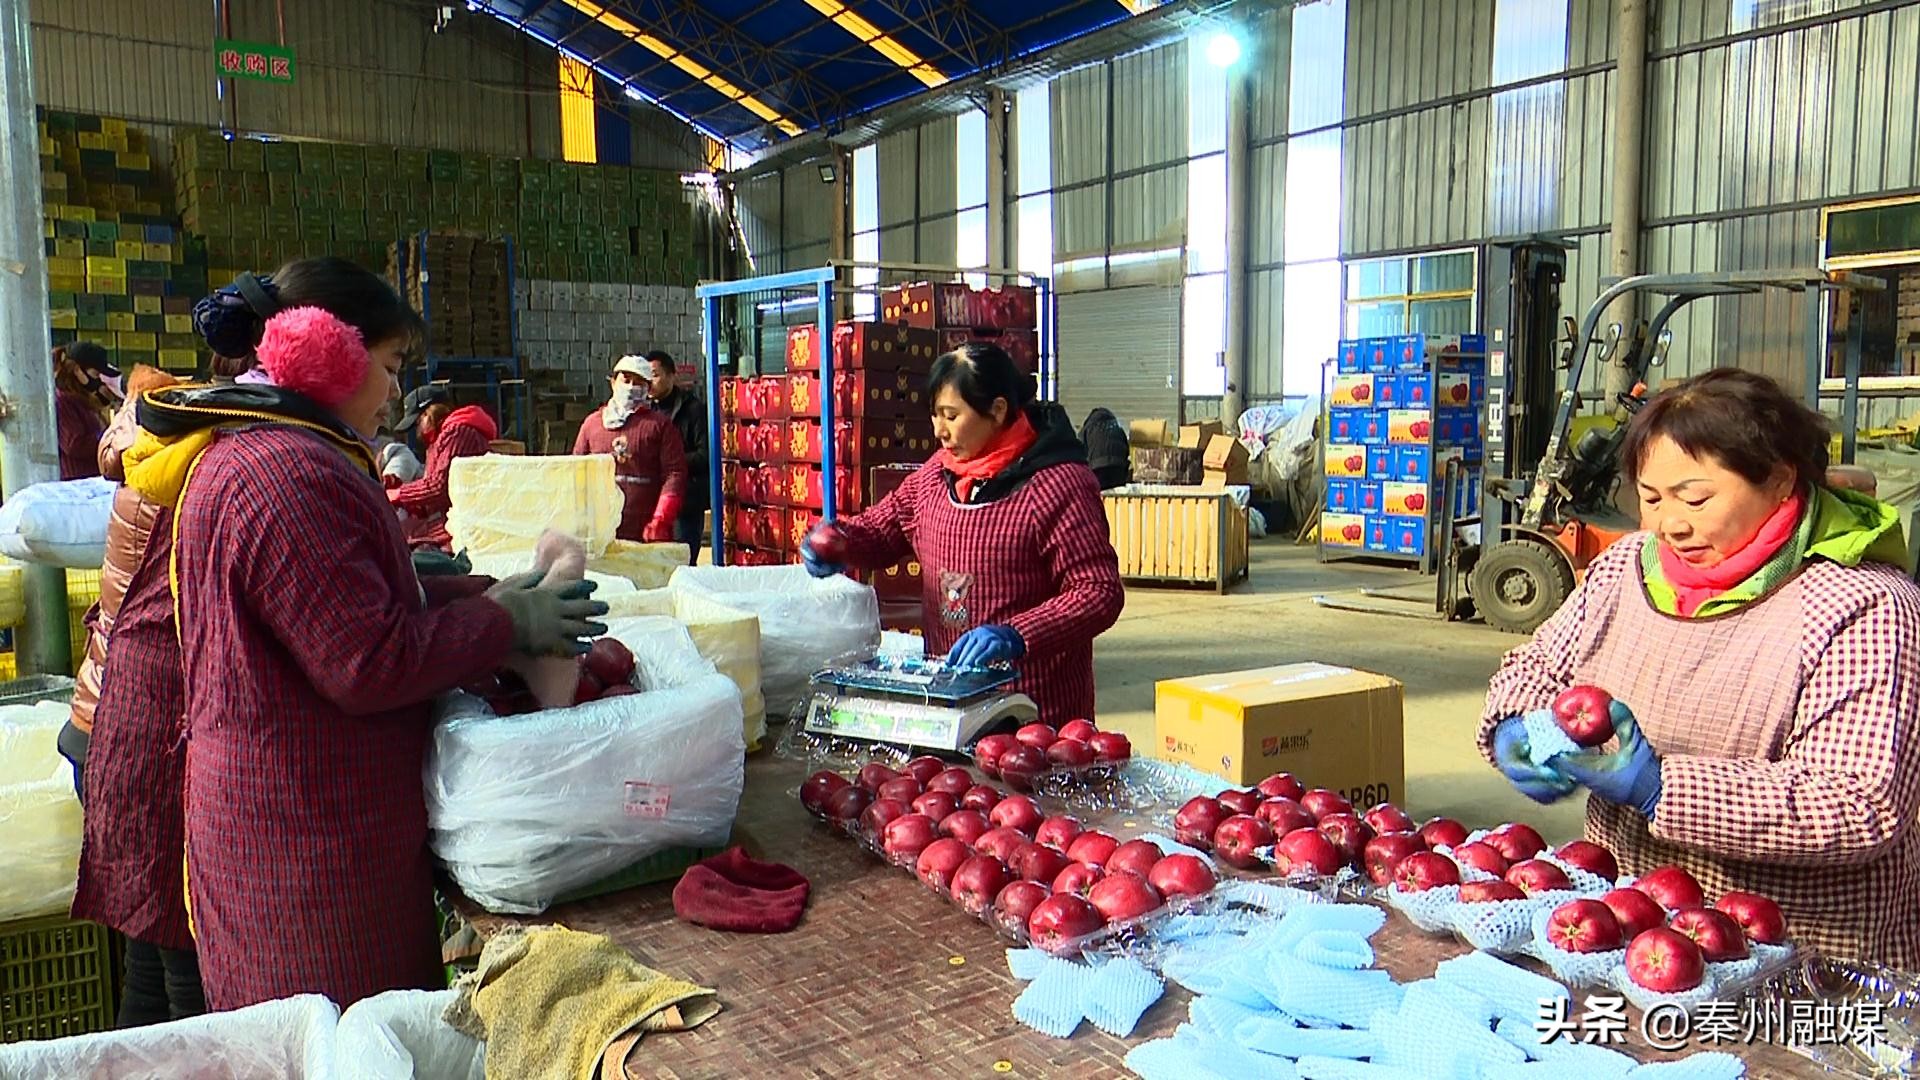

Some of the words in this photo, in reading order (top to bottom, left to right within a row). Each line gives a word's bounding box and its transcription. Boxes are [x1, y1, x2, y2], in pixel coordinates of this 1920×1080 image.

[220, 49, 291, 78] 收购区
[1487, 387, 1504, 443] HELI
